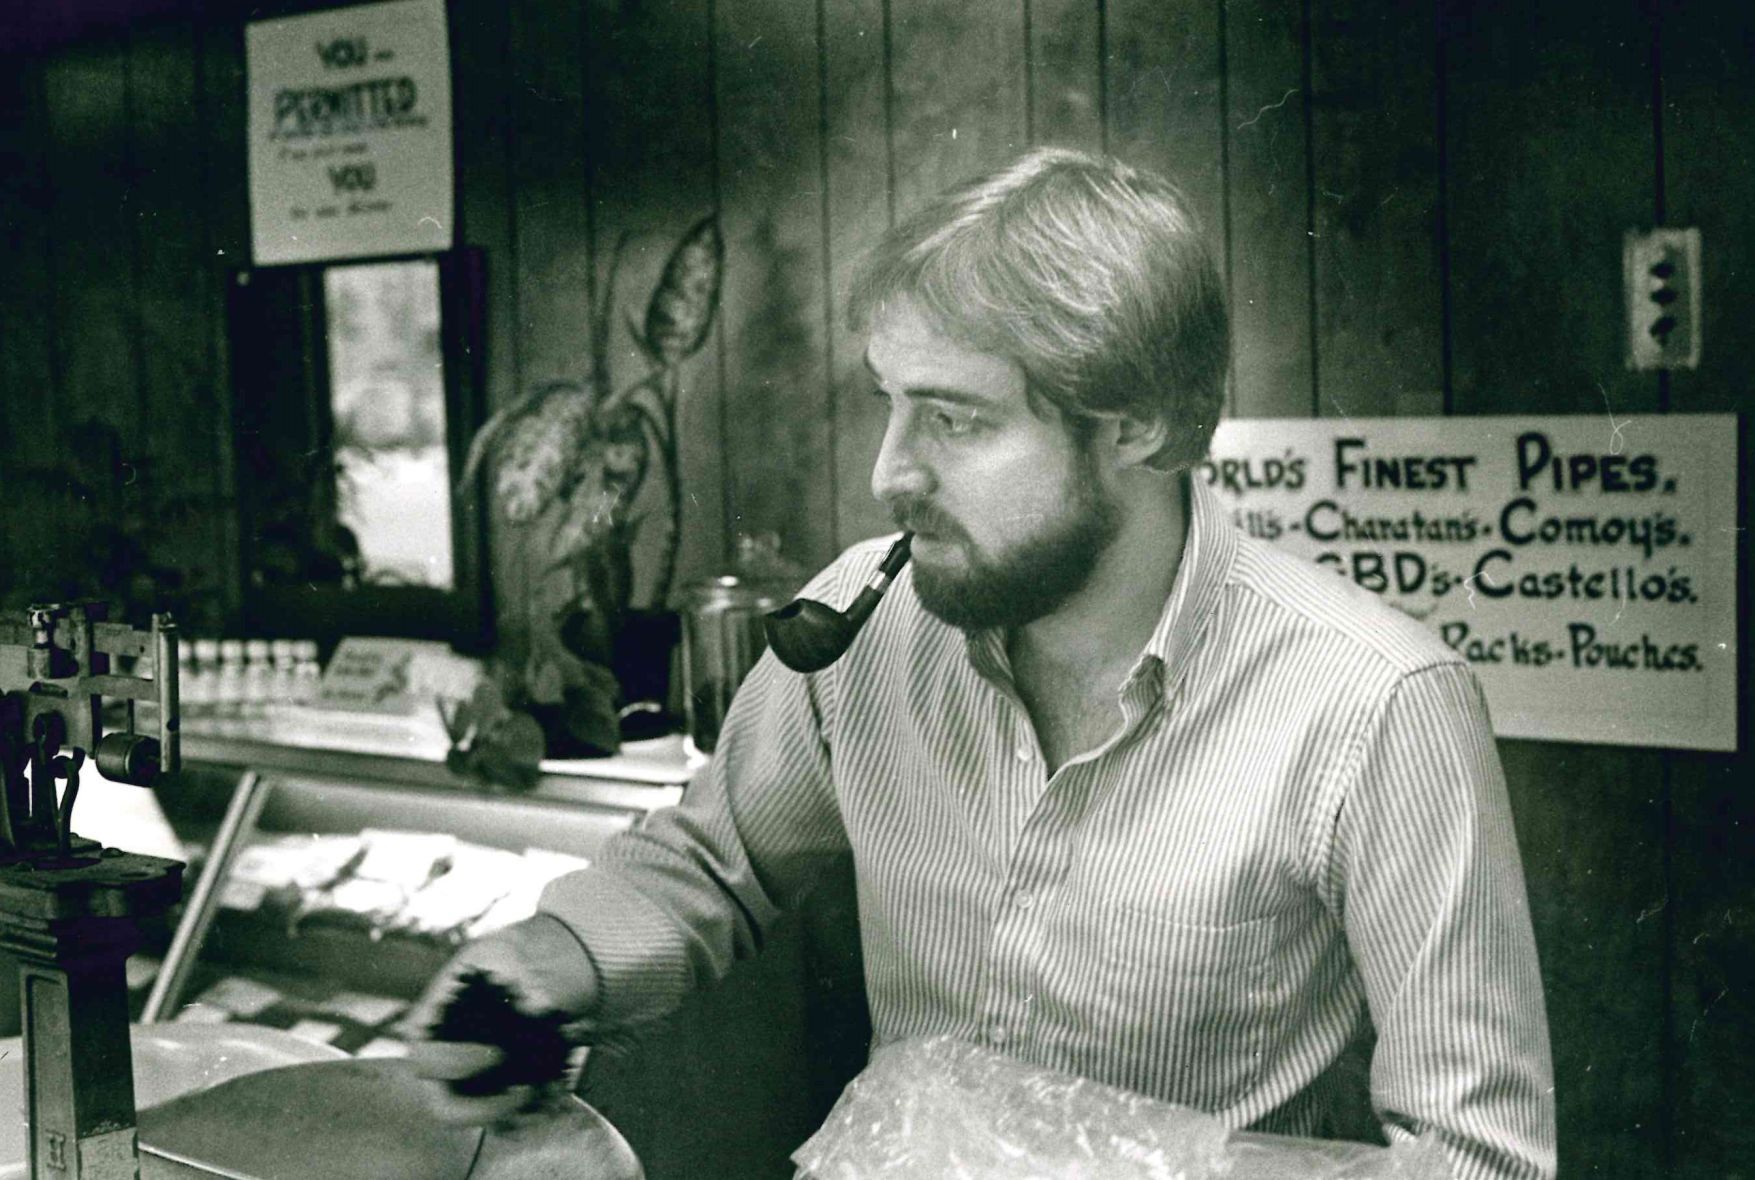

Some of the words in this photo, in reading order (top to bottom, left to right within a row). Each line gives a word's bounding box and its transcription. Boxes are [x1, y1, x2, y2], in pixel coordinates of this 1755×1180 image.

[1201, 448, 1305, 494] ORLD'S
[1334, 438, 1477, 489] FINEST
[1516, 431, 1678, 492] PIPES.
